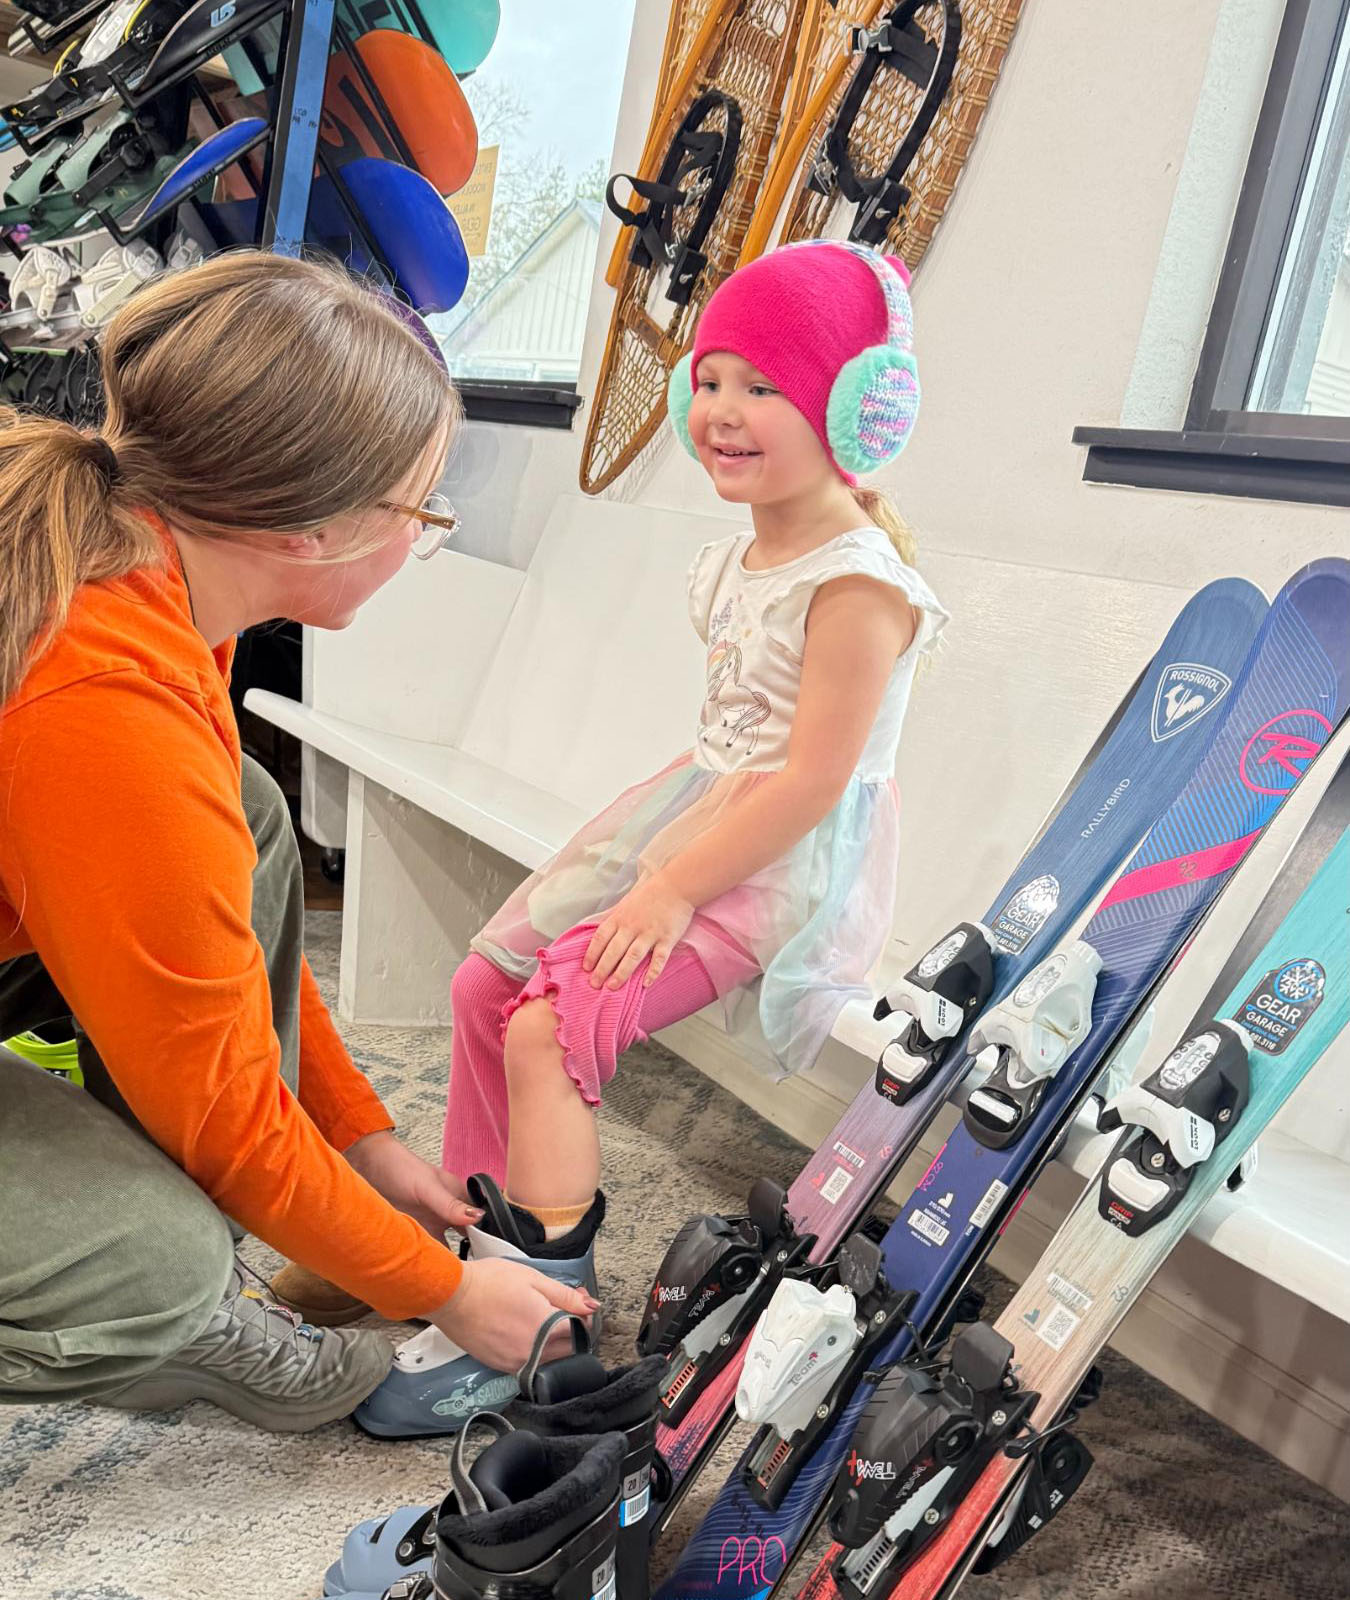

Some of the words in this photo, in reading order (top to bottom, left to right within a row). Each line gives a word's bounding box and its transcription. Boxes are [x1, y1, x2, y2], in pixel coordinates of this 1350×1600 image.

[1169, 669, 1222, 692] ROSSIGNOL
[1081, 777, 1131, 839] RALLYBIRD
[1007, 906, 1040, 929] GEAR
[998, 921, 1029, 939] GARAGE
[1256, 994, 1302, 1024] GEAR
[1246, 1011, 1289, 1037] GARAGE
[1111, 1284, 1129, 1303] 92
